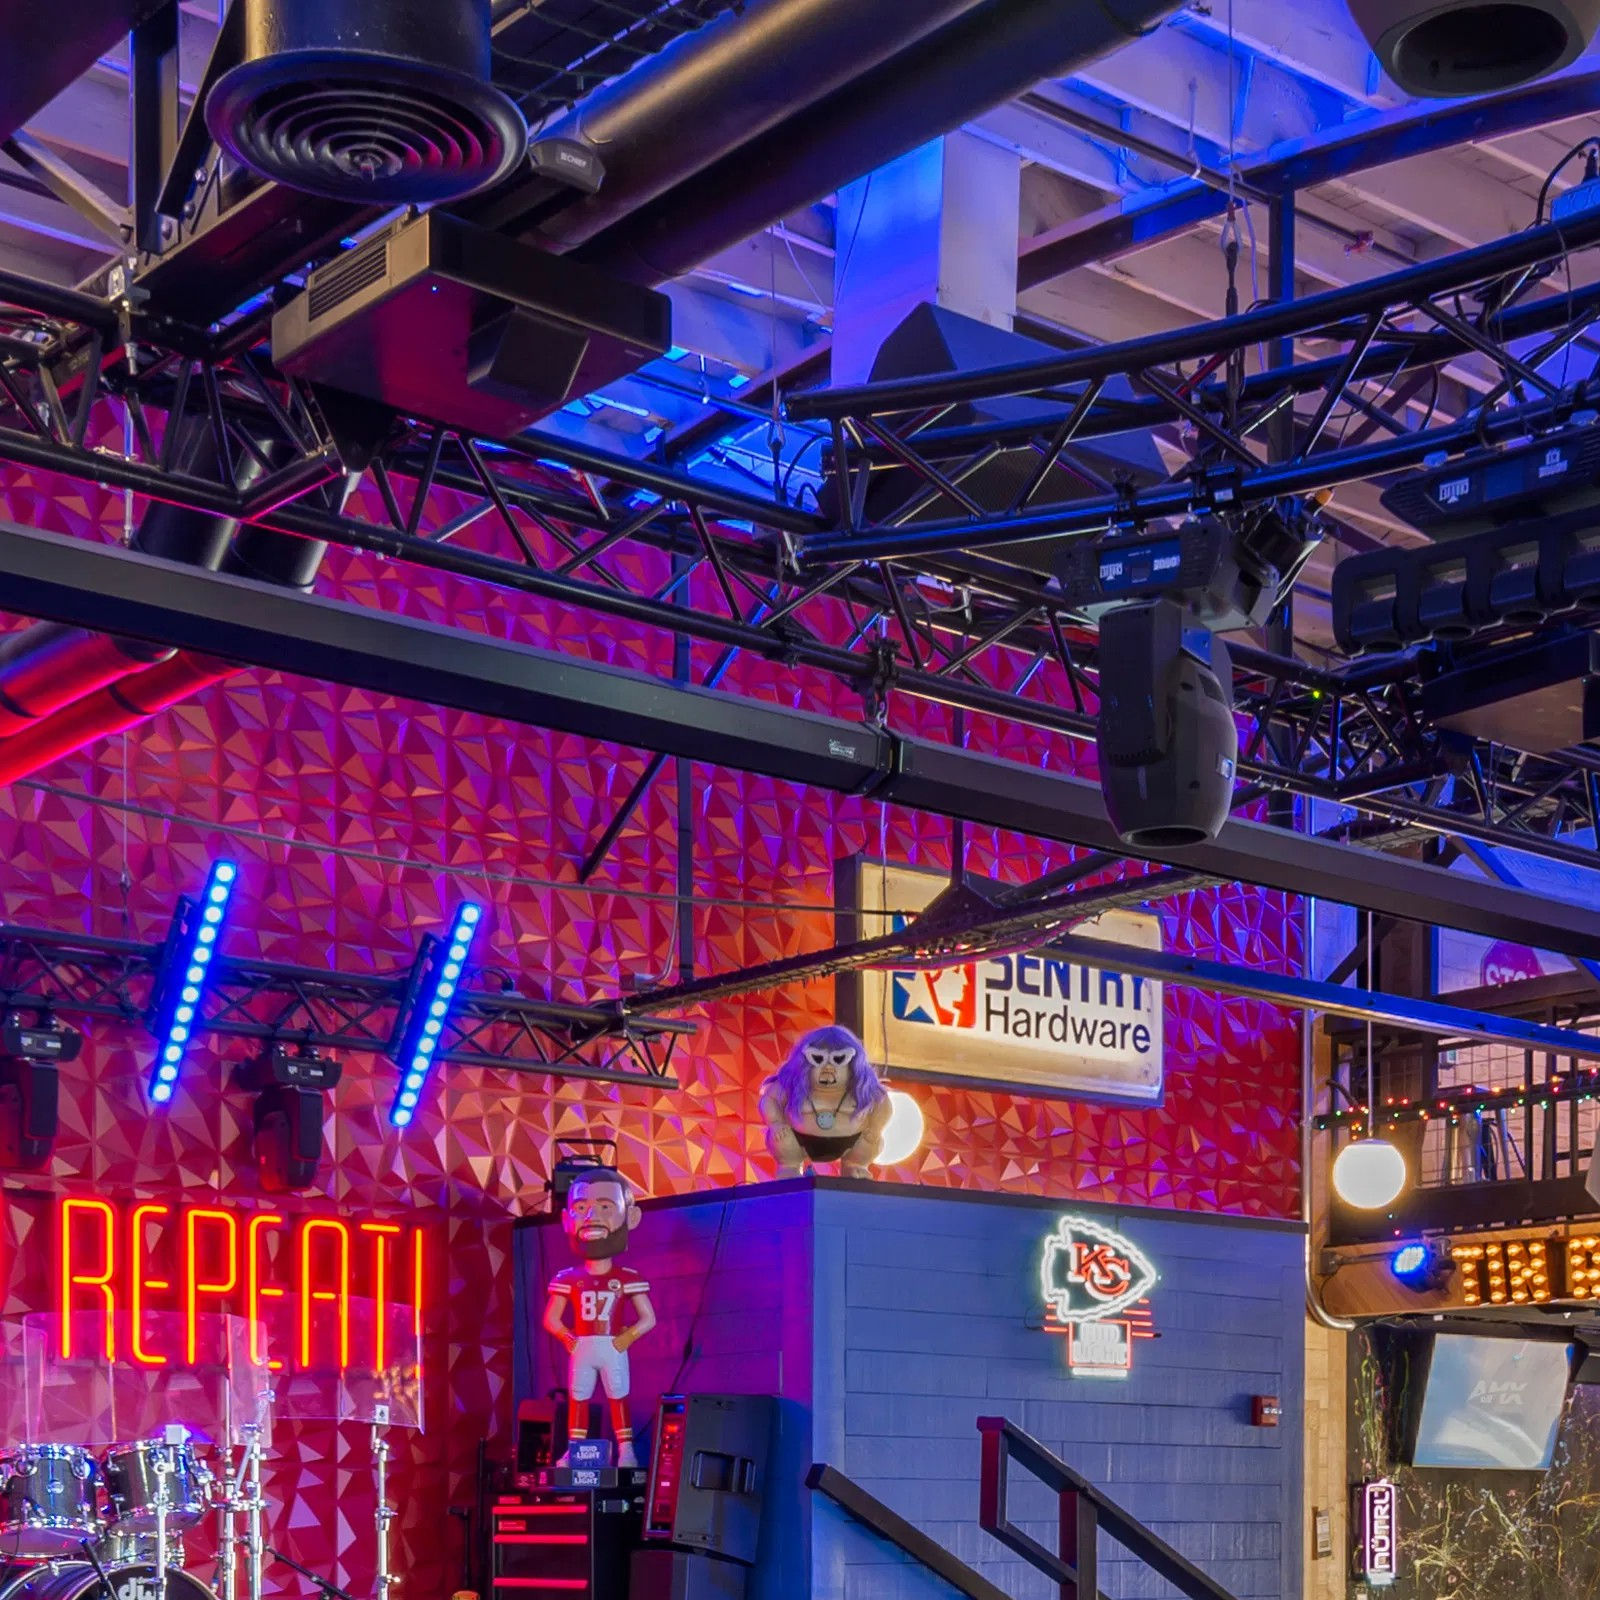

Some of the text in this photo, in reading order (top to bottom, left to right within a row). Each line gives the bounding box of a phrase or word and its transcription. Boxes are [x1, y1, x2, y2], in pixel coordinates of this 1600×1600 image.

[985, 994, 1151, 1054] Hardware
[59, 1197, 426, 1380] REPEAT!
[1450, 1237, 1552, 1306] TIN
[581, 1290, 616, 1321] 87
